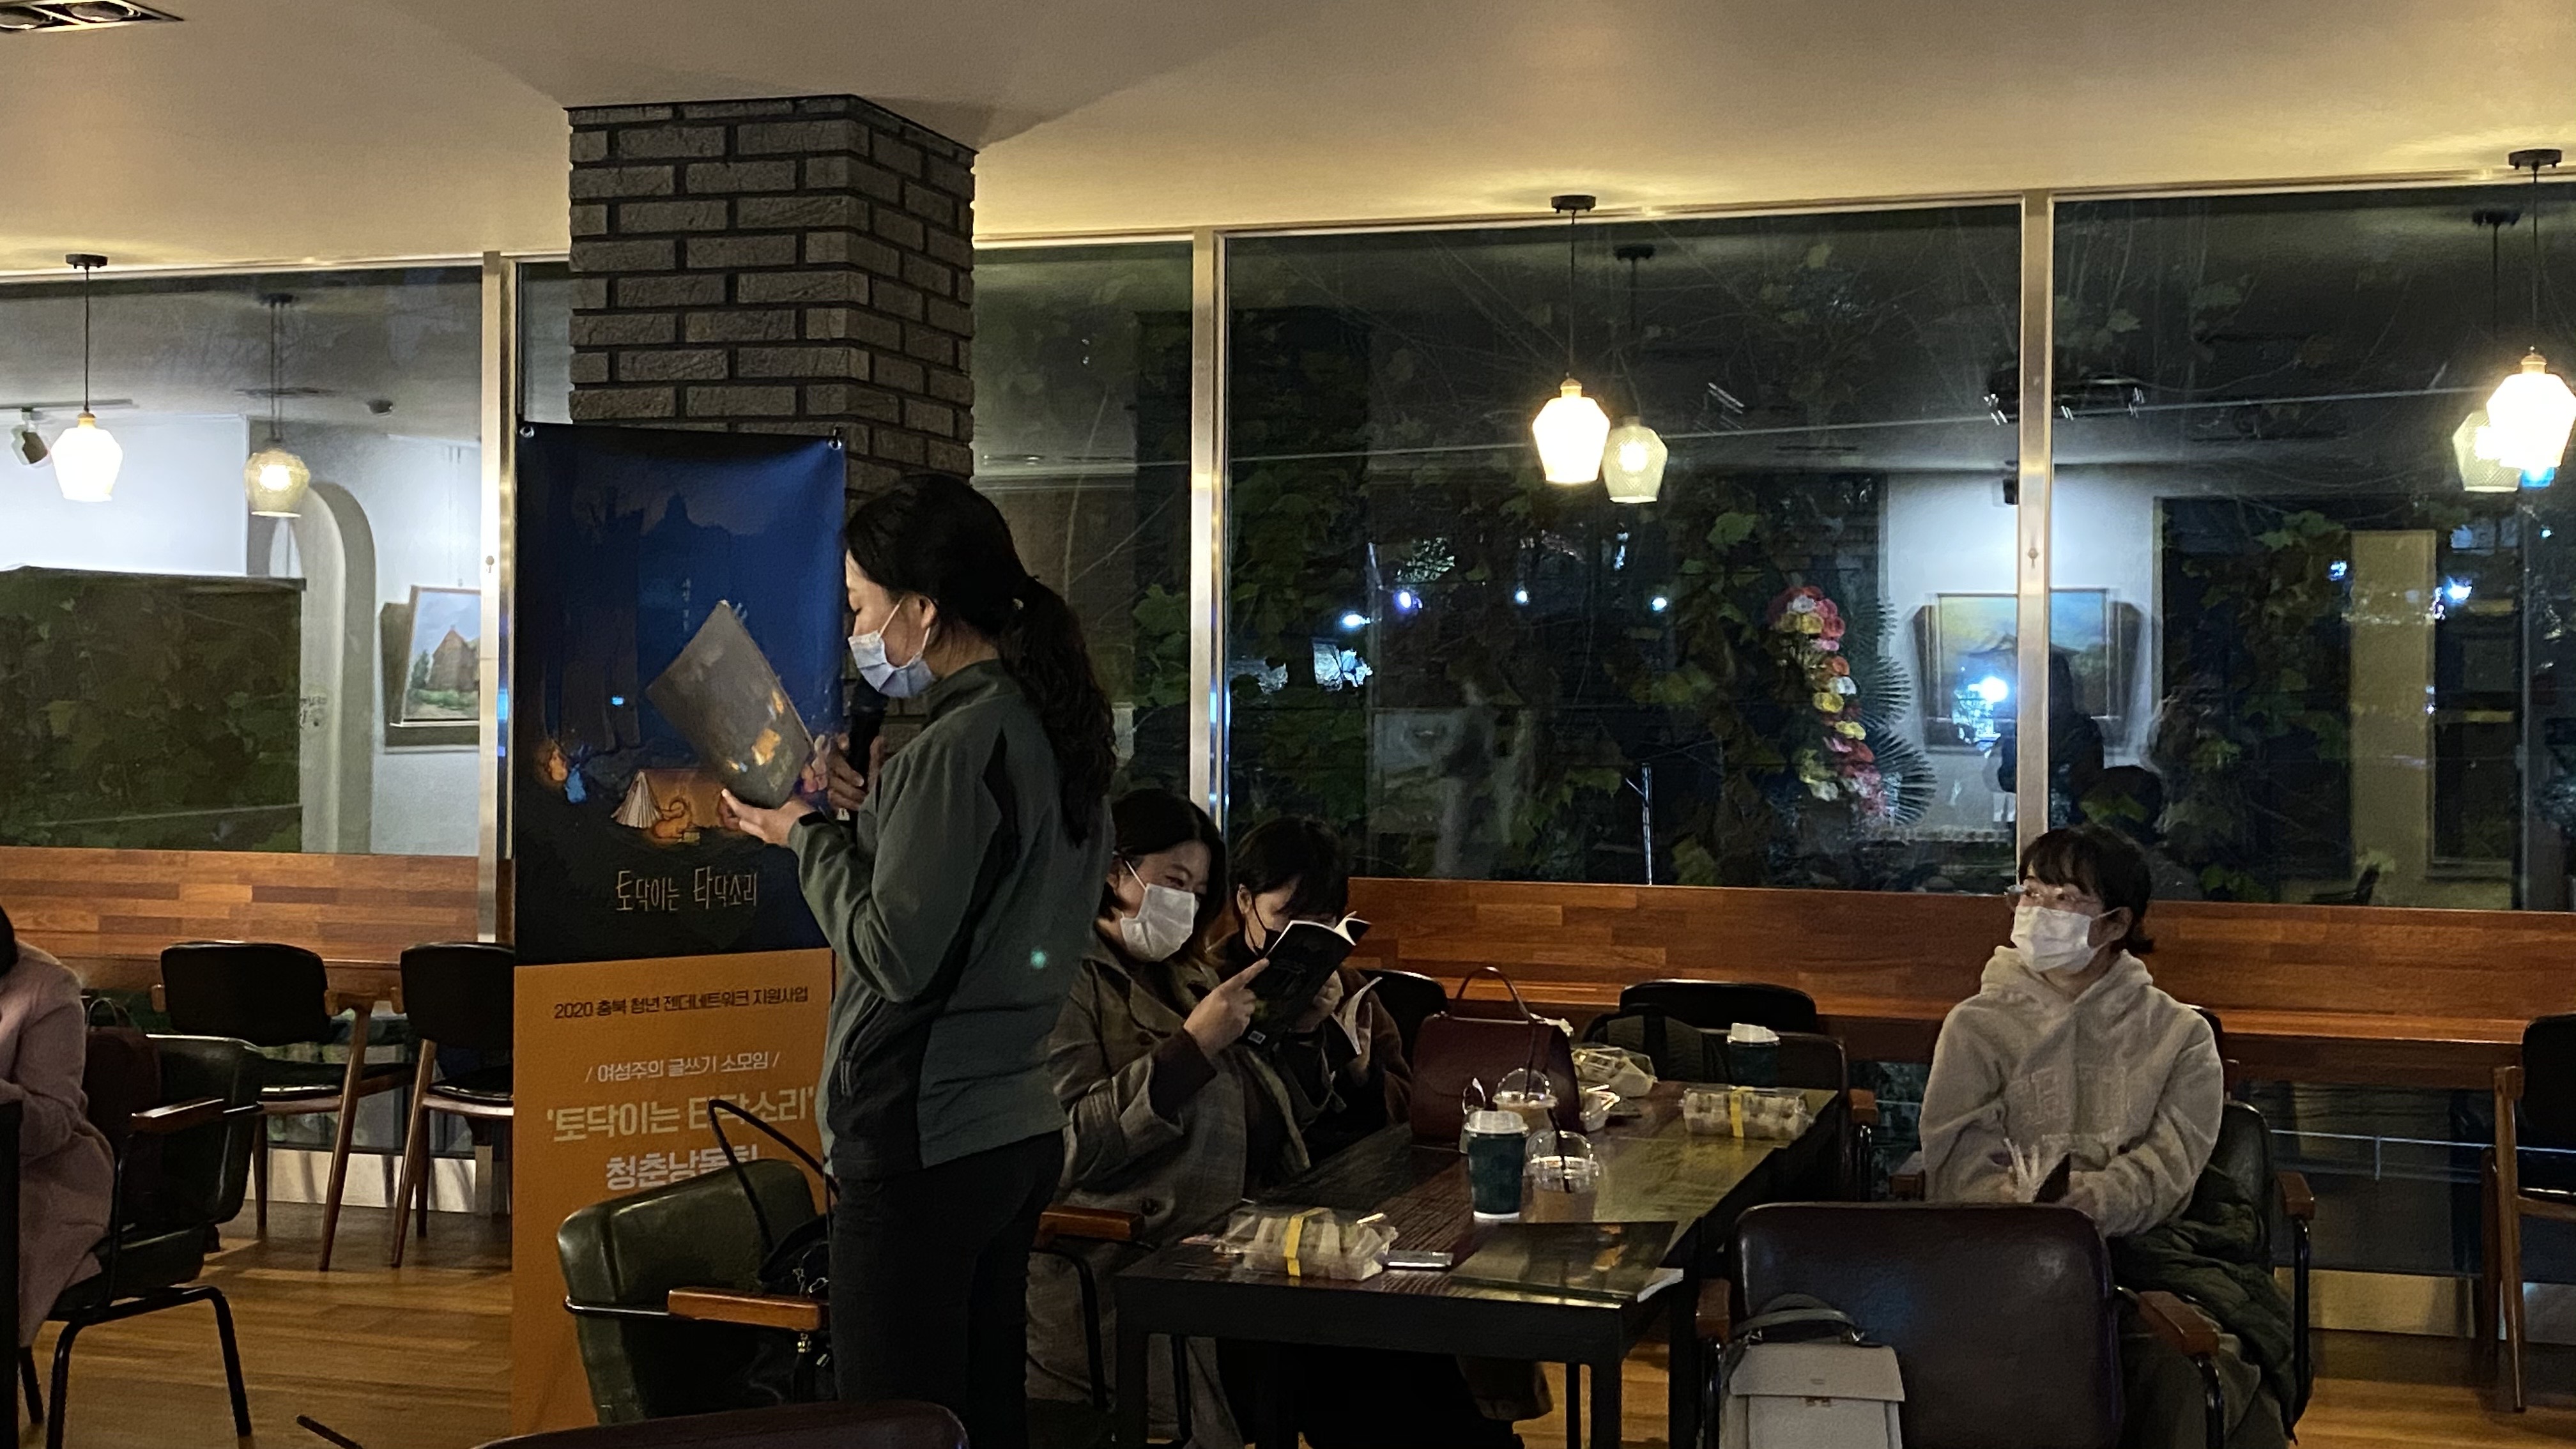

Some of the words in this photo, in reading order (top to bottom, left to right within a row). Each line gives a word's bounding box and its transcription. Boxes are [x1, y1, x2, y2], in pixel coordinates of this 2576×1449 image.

[615, 870, 680, 912] 토닥이는
[693, 866, 757, 910] 타닥소리
[554, 1001, 594, 1019] 2020
[597, 999, 627, 1016] 충북
[631, 996, 660, 1015] 청년
[663, 990, 749, 1012] 젠더네트워크
[752, 986, 808, 1006] 지원사업
[597, 1060, 664, 1082] 여성주의
[668, 1056, 717, 1077] 글쓰기
[721, 1051, 769, 1073] 소모임
